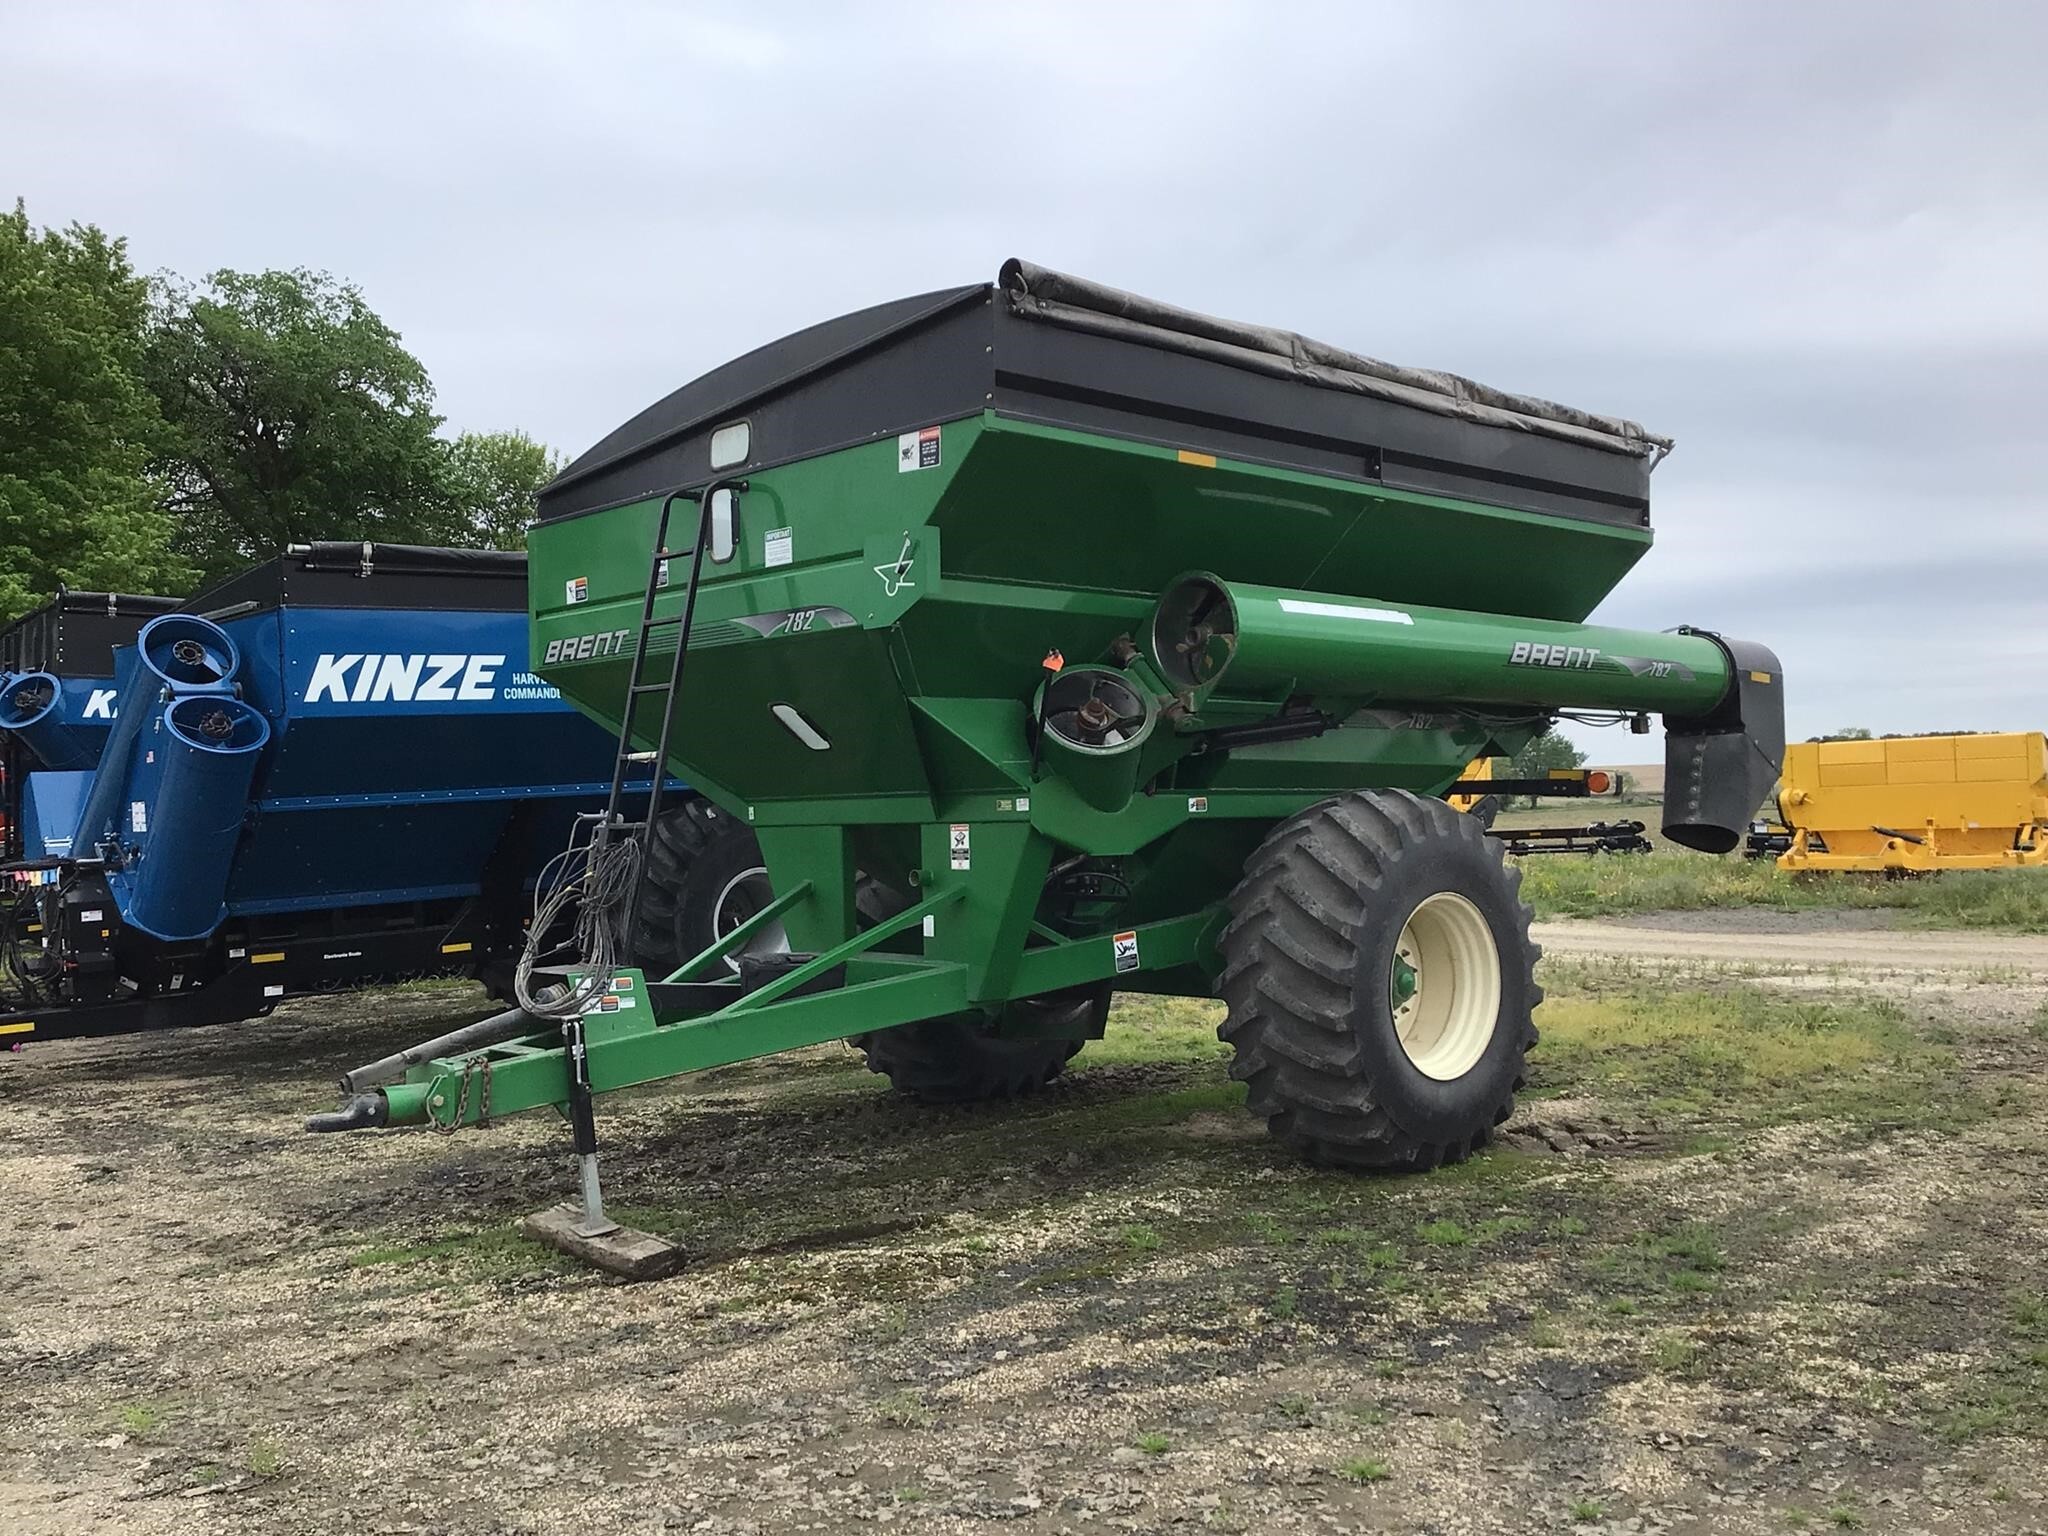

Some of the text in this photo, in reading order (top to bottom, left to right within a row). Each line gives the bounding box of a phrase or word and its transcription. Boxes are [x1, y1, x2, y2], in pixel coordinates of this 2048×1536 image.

[784, 610, 815, 633] 782
[544, 629, 630, 664] BRENT
[1510, 641, 1600, 668] BRENT
[303, 654, 506, 702] KINZE
[1650, 661, 1671, 678] 782
[1408, 712, 1433, 729] 782
